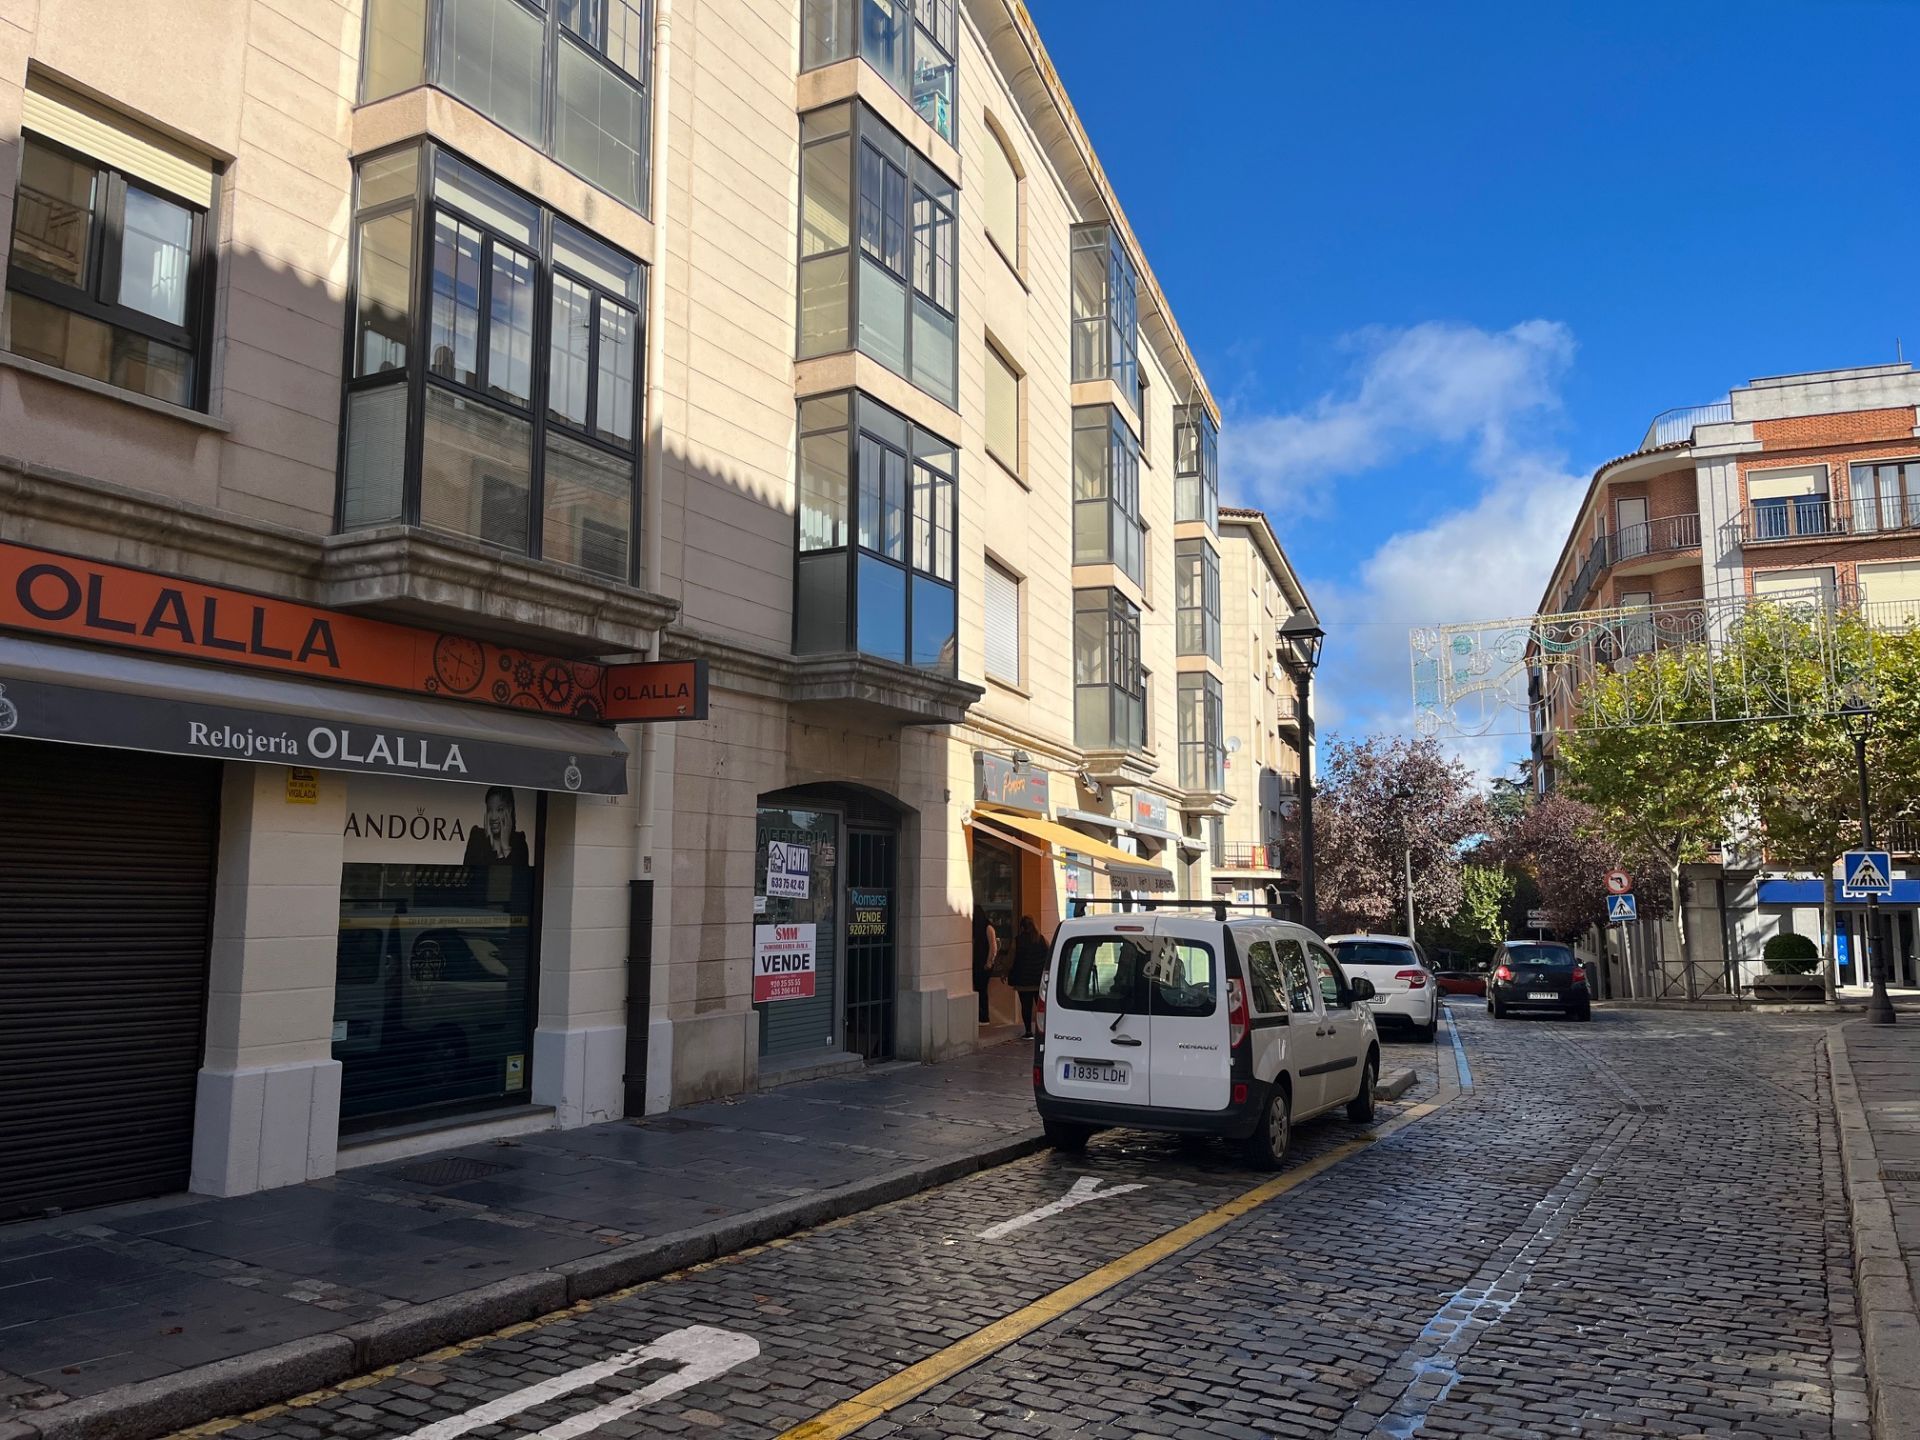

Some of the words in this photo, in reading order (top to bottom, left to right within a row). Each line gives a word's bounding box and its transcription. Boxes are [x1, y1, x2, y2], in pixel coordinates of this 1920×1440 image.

[16, 564, 340, 668] OLALLA
[613, 683, 689, 701] OLALLA
[188, 721, 298, 755] Relojería
[307, 727, 468, 773] OLALLA
[787, 847, 808, 872] VENTA
[852, 890, 887, 906] Romarsa
[856, 912, 881, 922] VENDE
[776, 927, 798, 940] SMM
[849, 925, 885, 935] 920217095
[761, 953, 810, 973] VENDE
[1073, 1066, 1099, 1080] 1835
[1103, 1068, 1126, 1082] LDH
